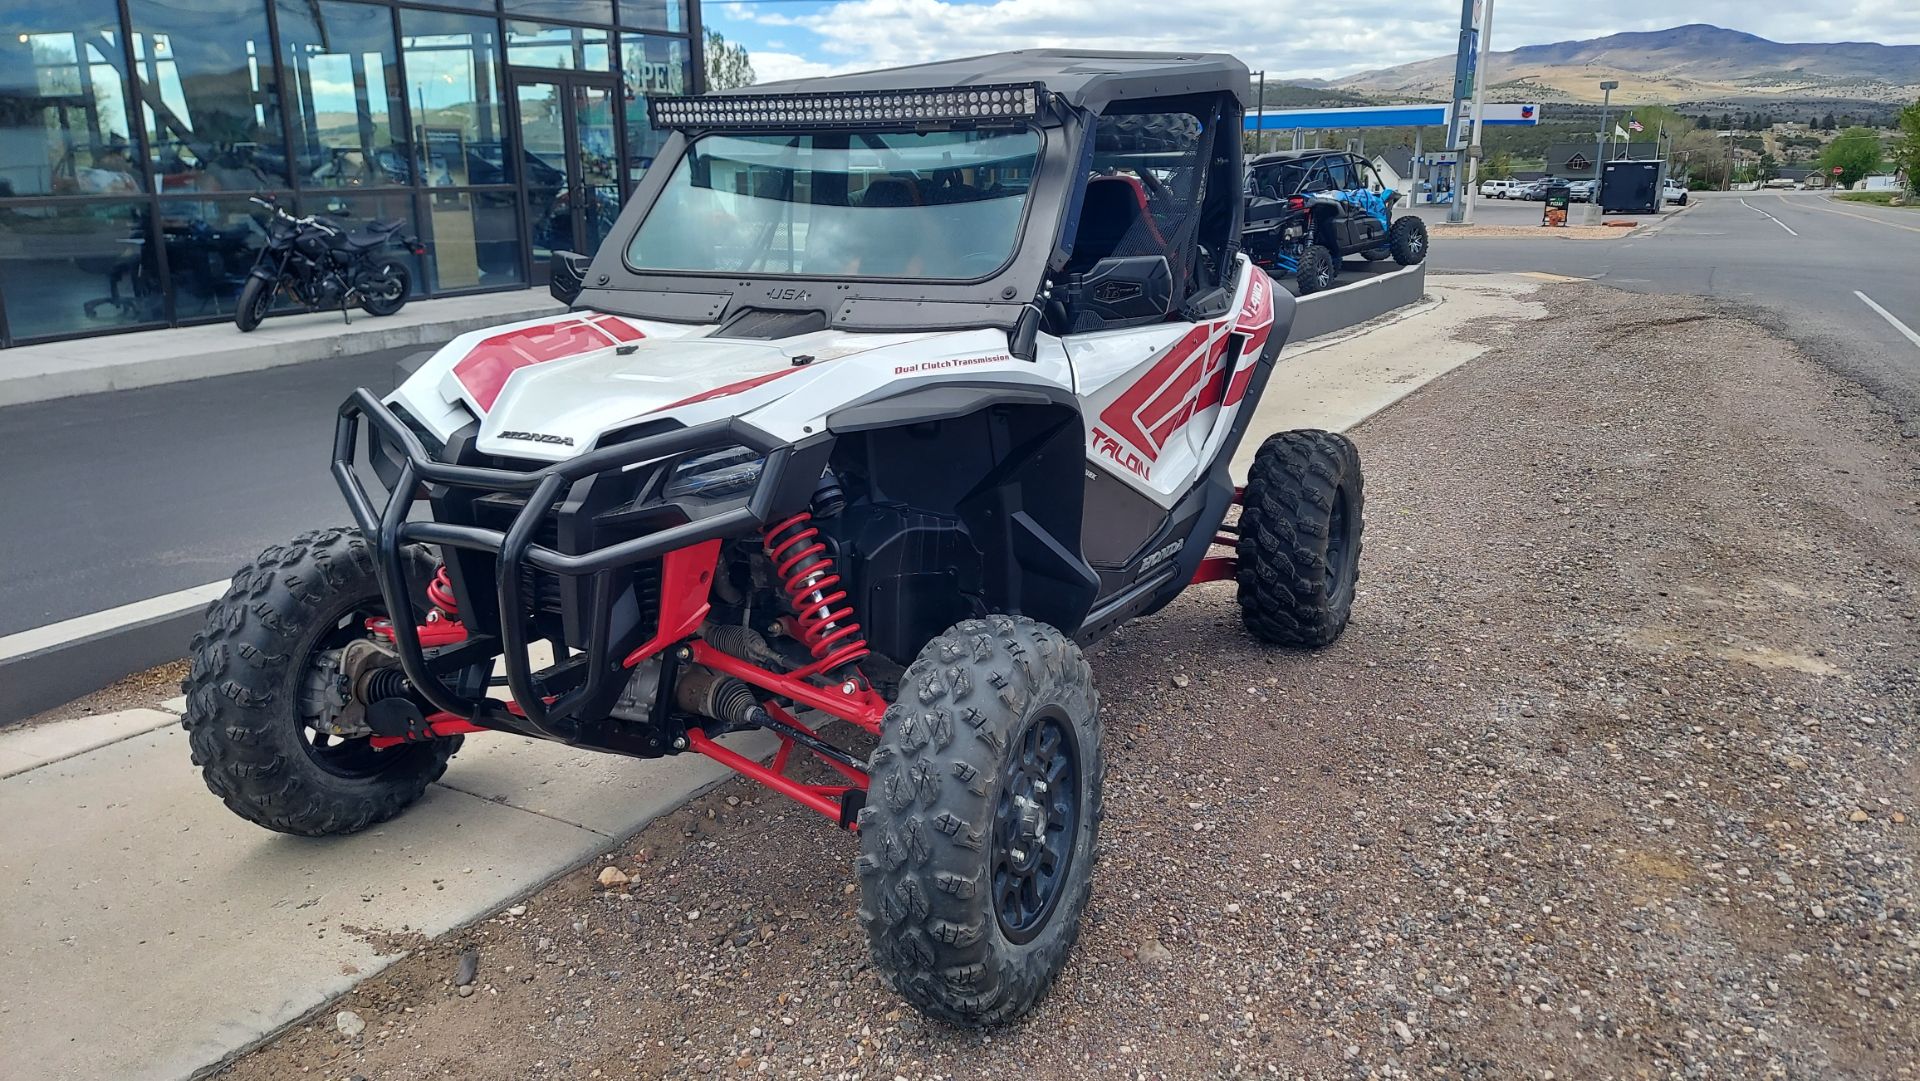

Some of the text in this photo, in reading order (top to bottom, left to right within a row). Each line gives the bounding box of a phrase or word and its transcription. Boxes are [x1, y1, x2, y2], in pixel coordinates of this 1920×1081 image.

[627, 62, 684, 96] OPEN
[894, 354, 1010, 375] Dual Clutch Transmission
[497, 431, 574, 446] HONDA
[1091, 426, 1151, 482] TALON
[1138, 538, 1184, 573] HONDA
